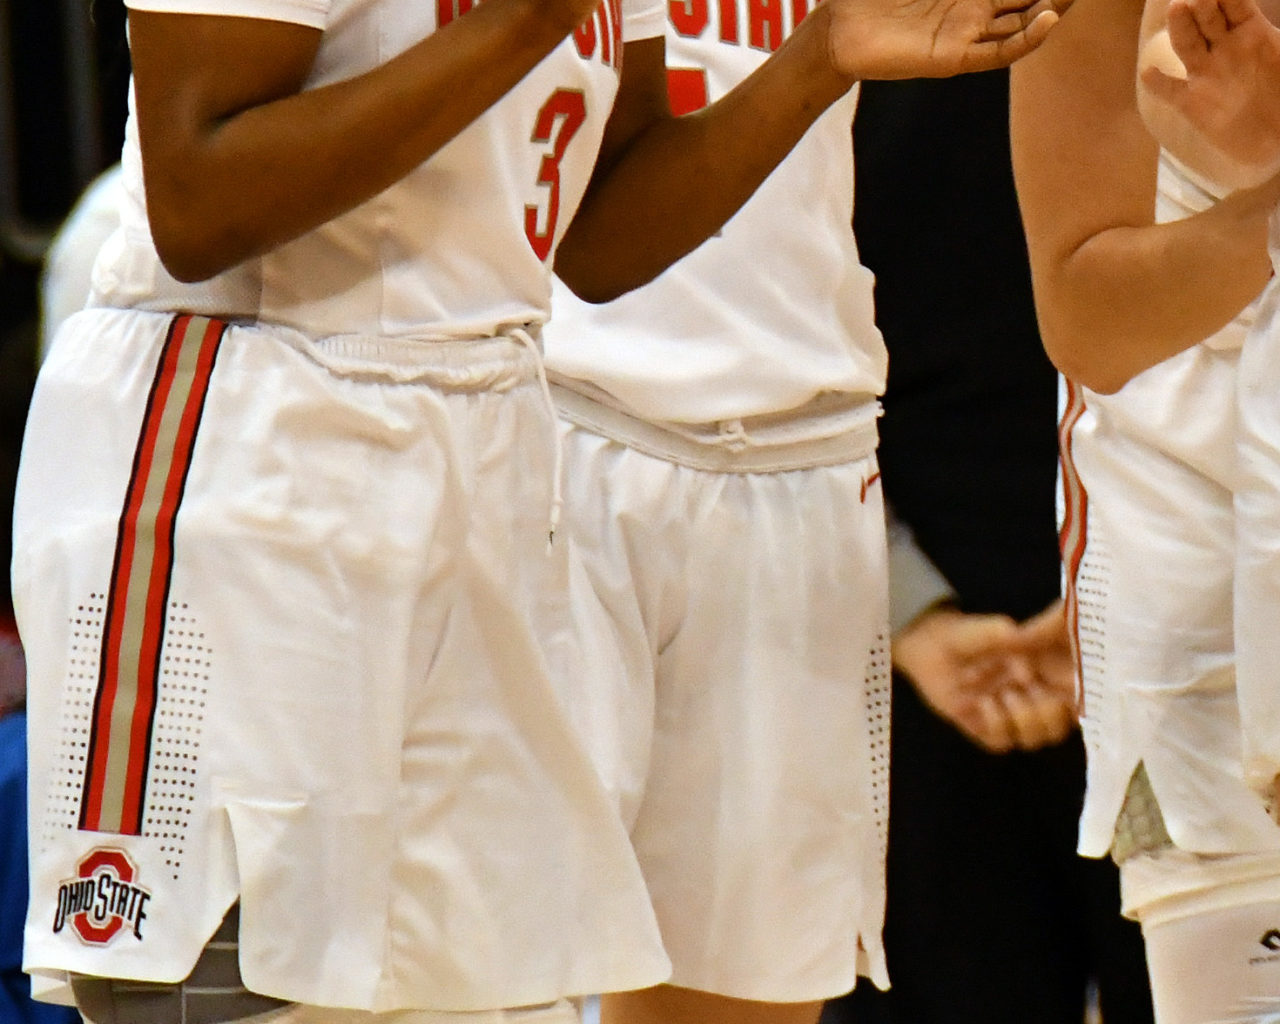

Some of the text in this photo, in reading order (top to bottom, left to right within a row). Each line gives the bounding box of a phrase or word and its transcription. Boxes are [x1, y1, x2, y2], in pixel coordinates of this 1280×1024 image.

[523, 86, 587, 263] 3
[53, 873, 151, 941] OHIO STATE
